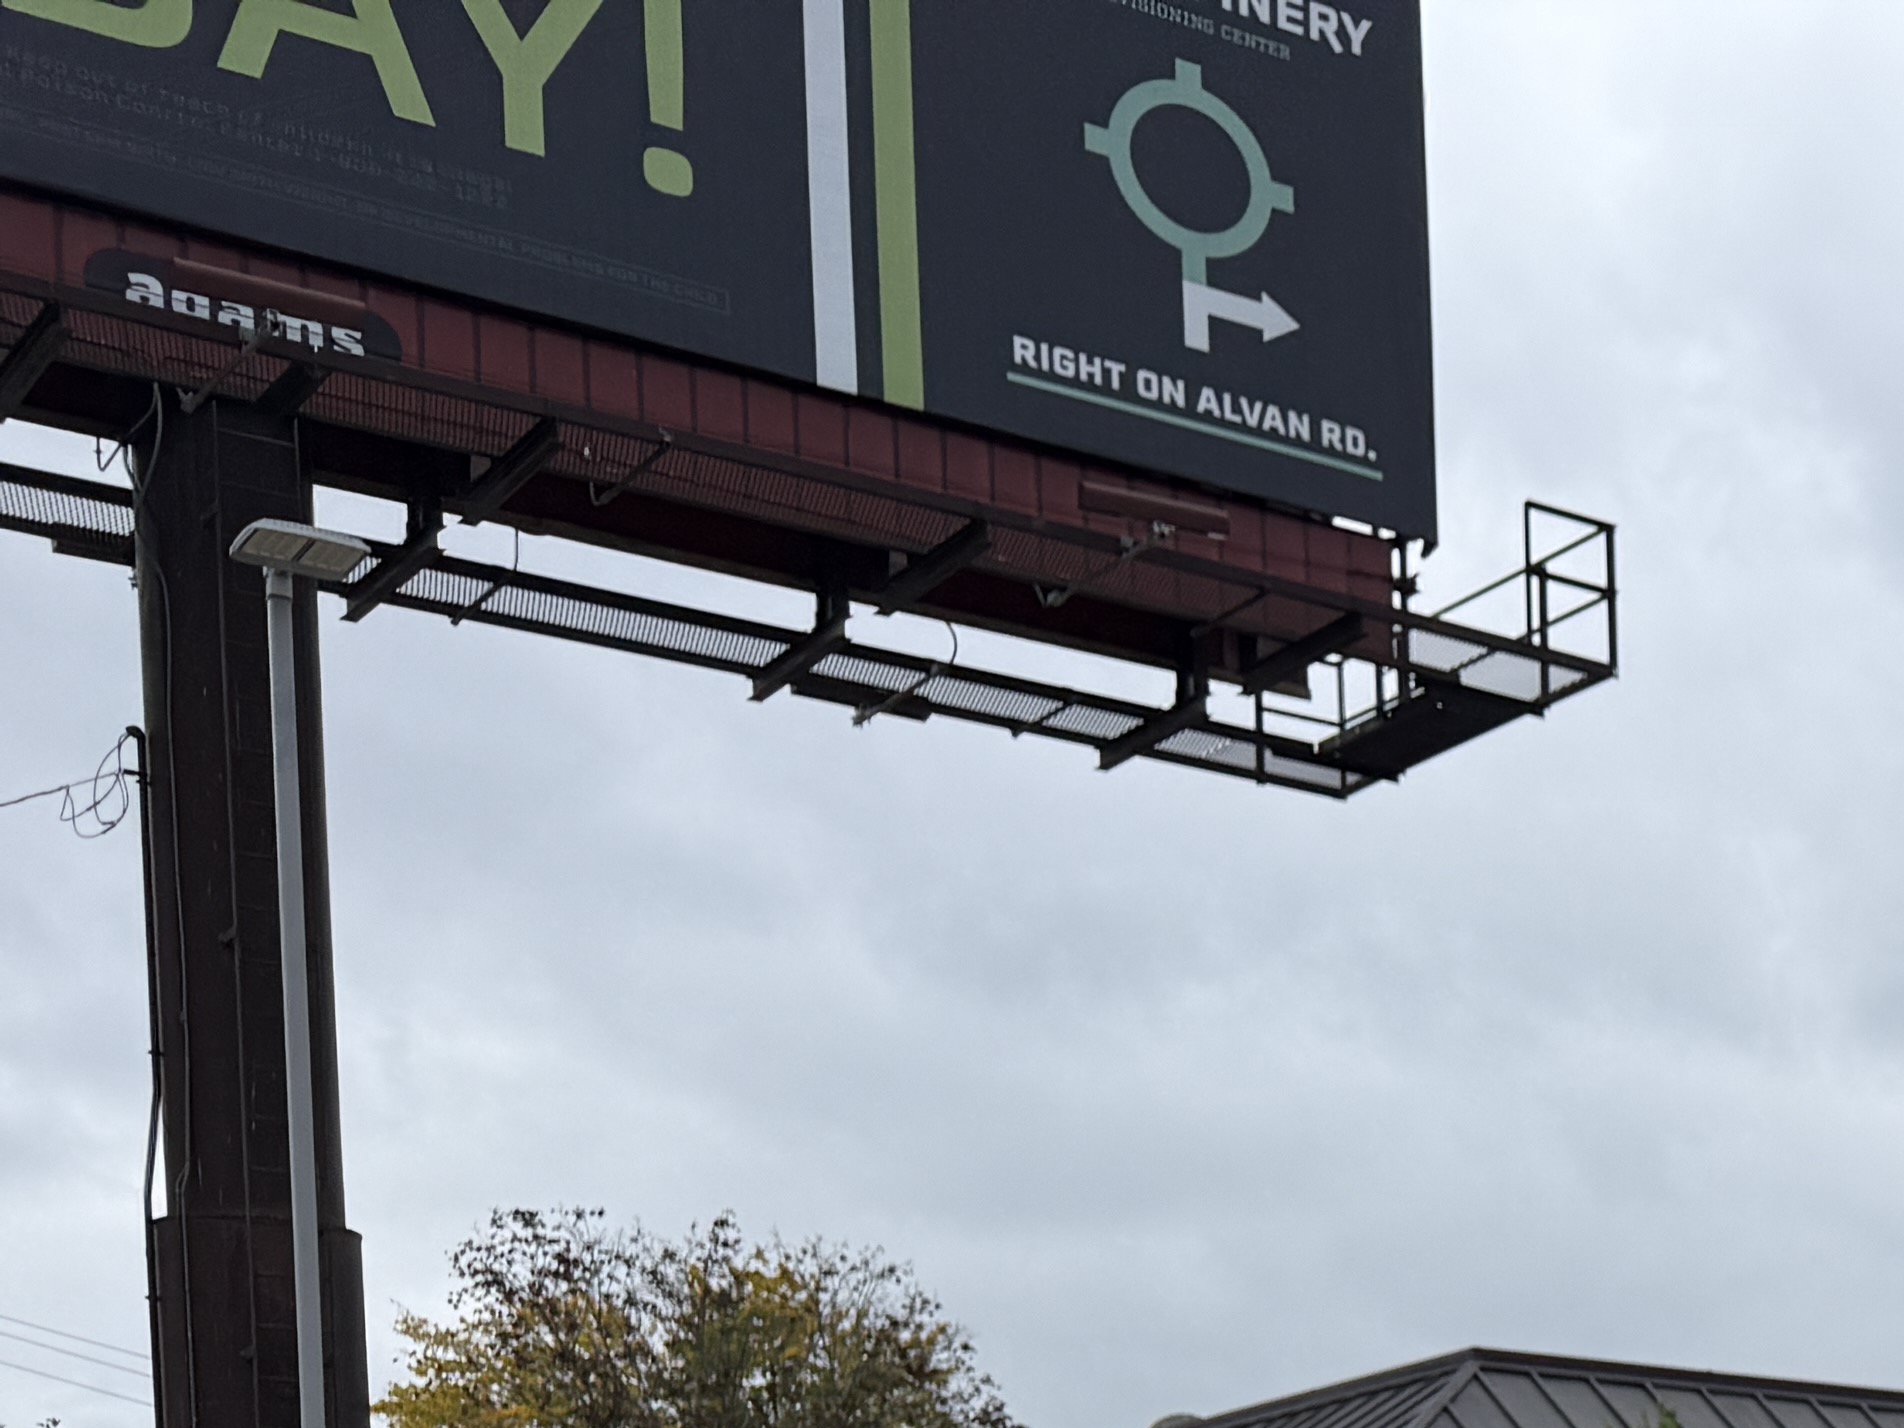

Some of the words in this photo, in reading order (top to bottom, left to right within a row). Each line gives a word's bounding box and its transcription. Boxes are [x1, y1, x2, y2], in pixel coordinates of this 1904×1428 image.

[0, 0, 692, 197] AY!
[1220, 25, 1290, 61] CENTER
[1012, 334, 1126, 391] RIGHT
[1136, 369, 1187, 408] ON
[1197, 386, 1311, 442] ALVAN
[1320, 418, 1377, 462] RD.
